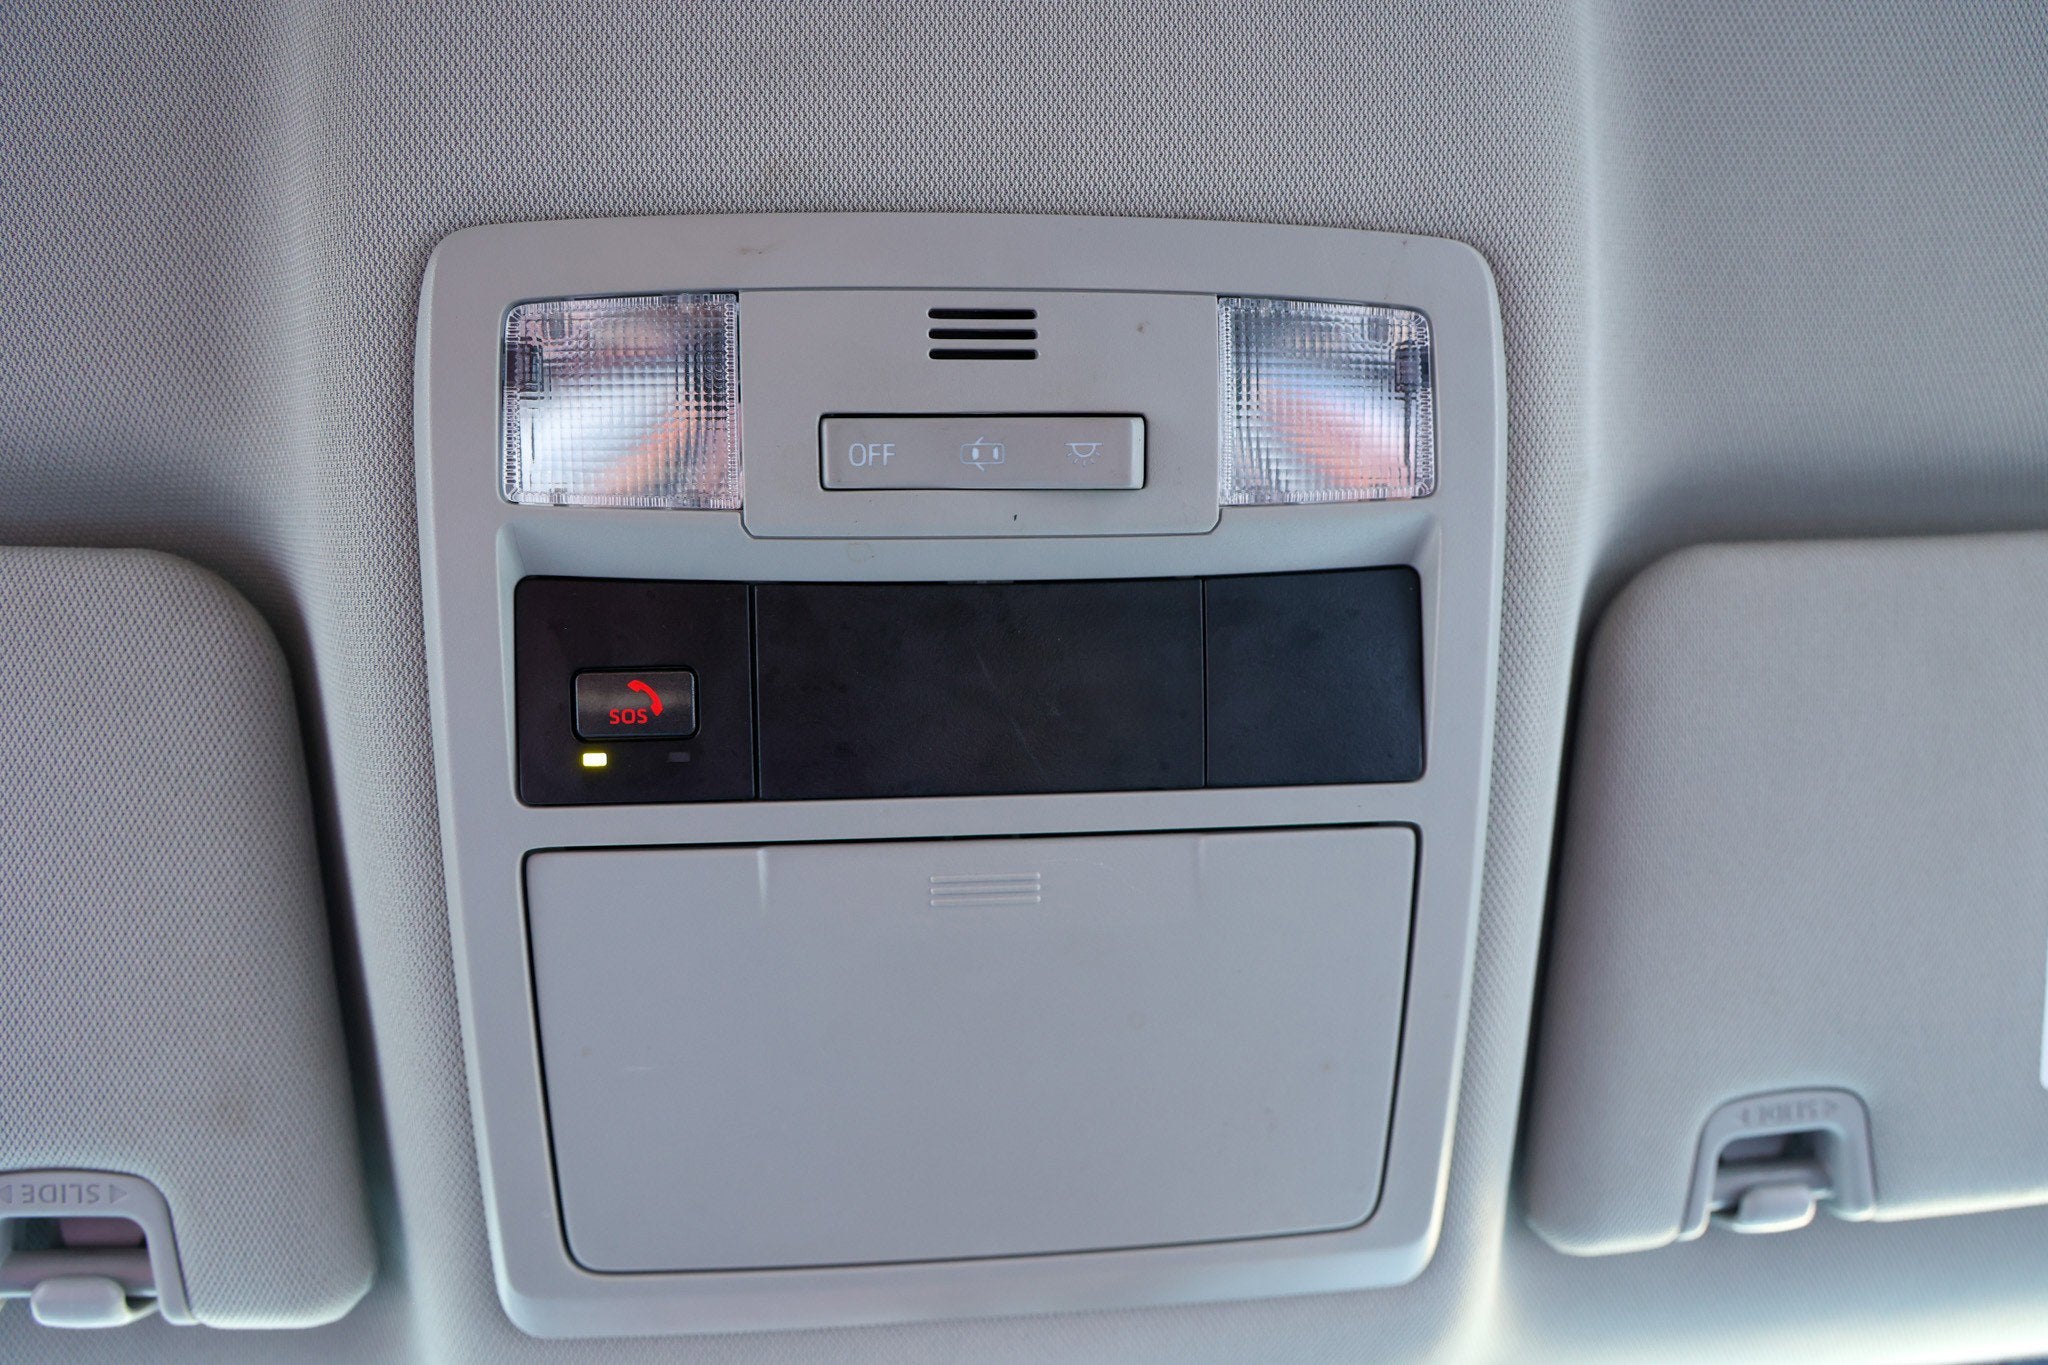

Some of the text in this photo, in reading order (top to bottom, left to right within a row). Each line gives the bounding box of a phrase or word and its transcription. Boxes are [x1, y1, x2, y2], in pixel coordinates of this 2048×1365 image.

[849, 443, 896, 467] OFF
[609, 708, 648, 725] SOS
[21, 1183, 100, 1204] SLIDE
